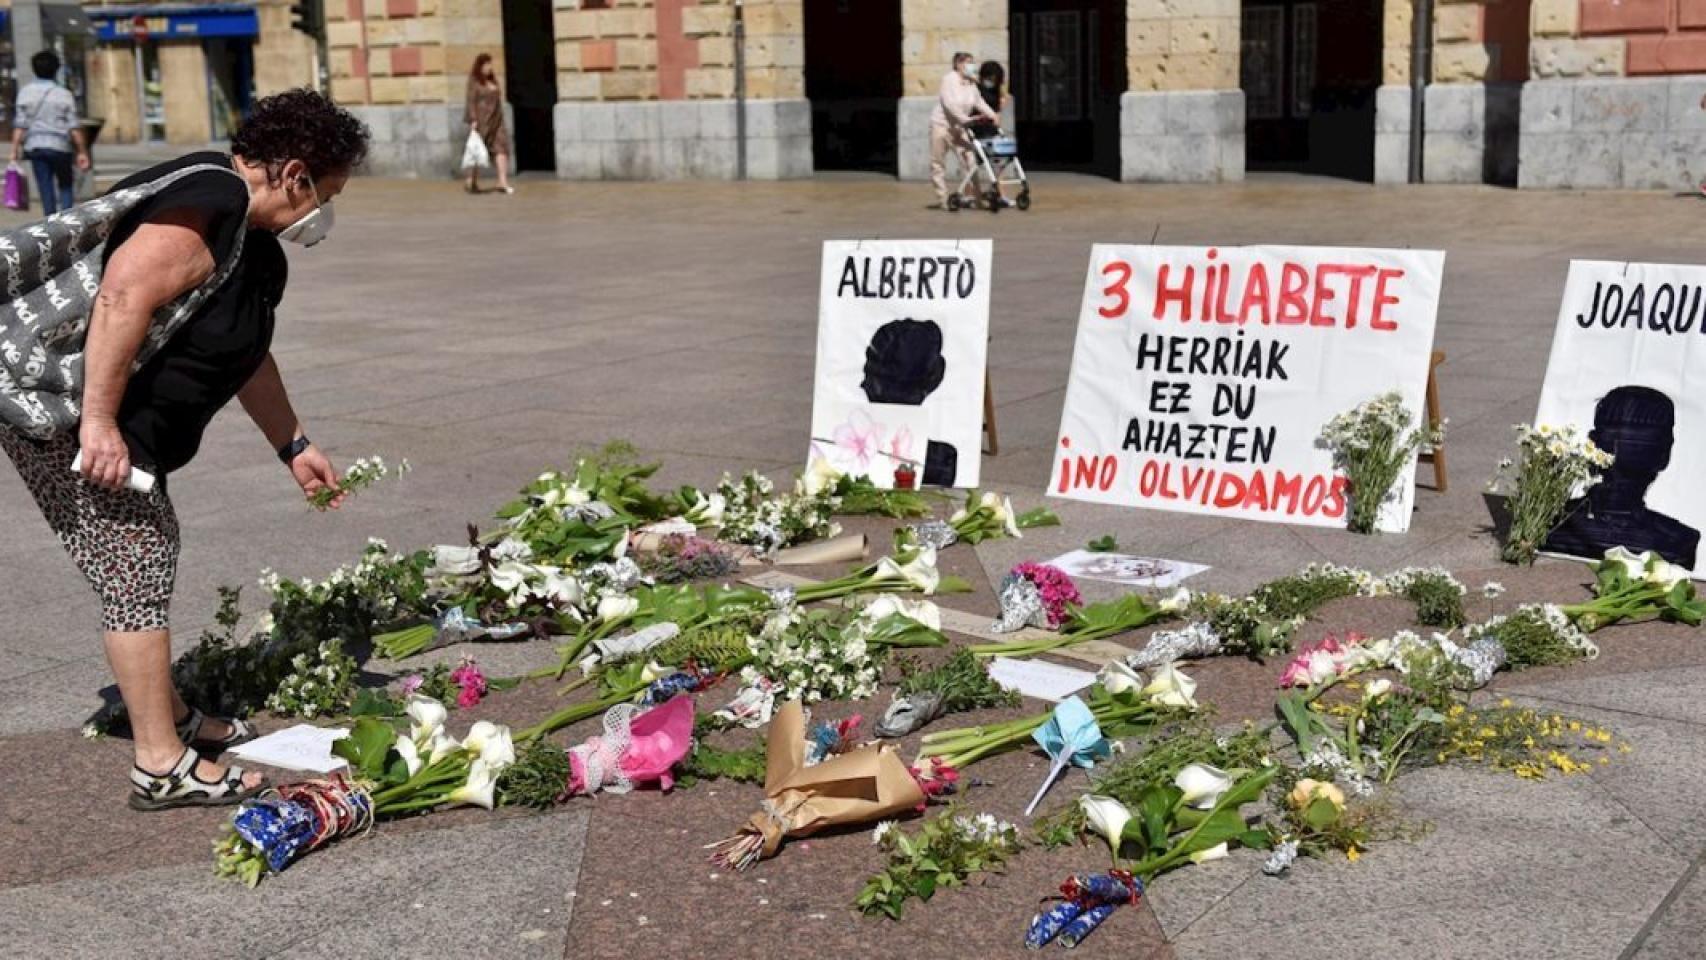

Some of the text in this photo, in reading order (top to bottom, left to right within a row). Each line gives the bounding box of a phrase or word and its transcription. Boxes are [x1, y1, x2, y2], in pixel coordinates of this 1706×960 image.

[837, 255, 976, 299] ALBERTO
[1098, 260, 1133, 319] 3
[1149, 381, 1256, 420] EZ DU
[1122, 417, 1277, 464] AHAZTEN
[1139, 459, 1352, 518] OLVIDAMOS
